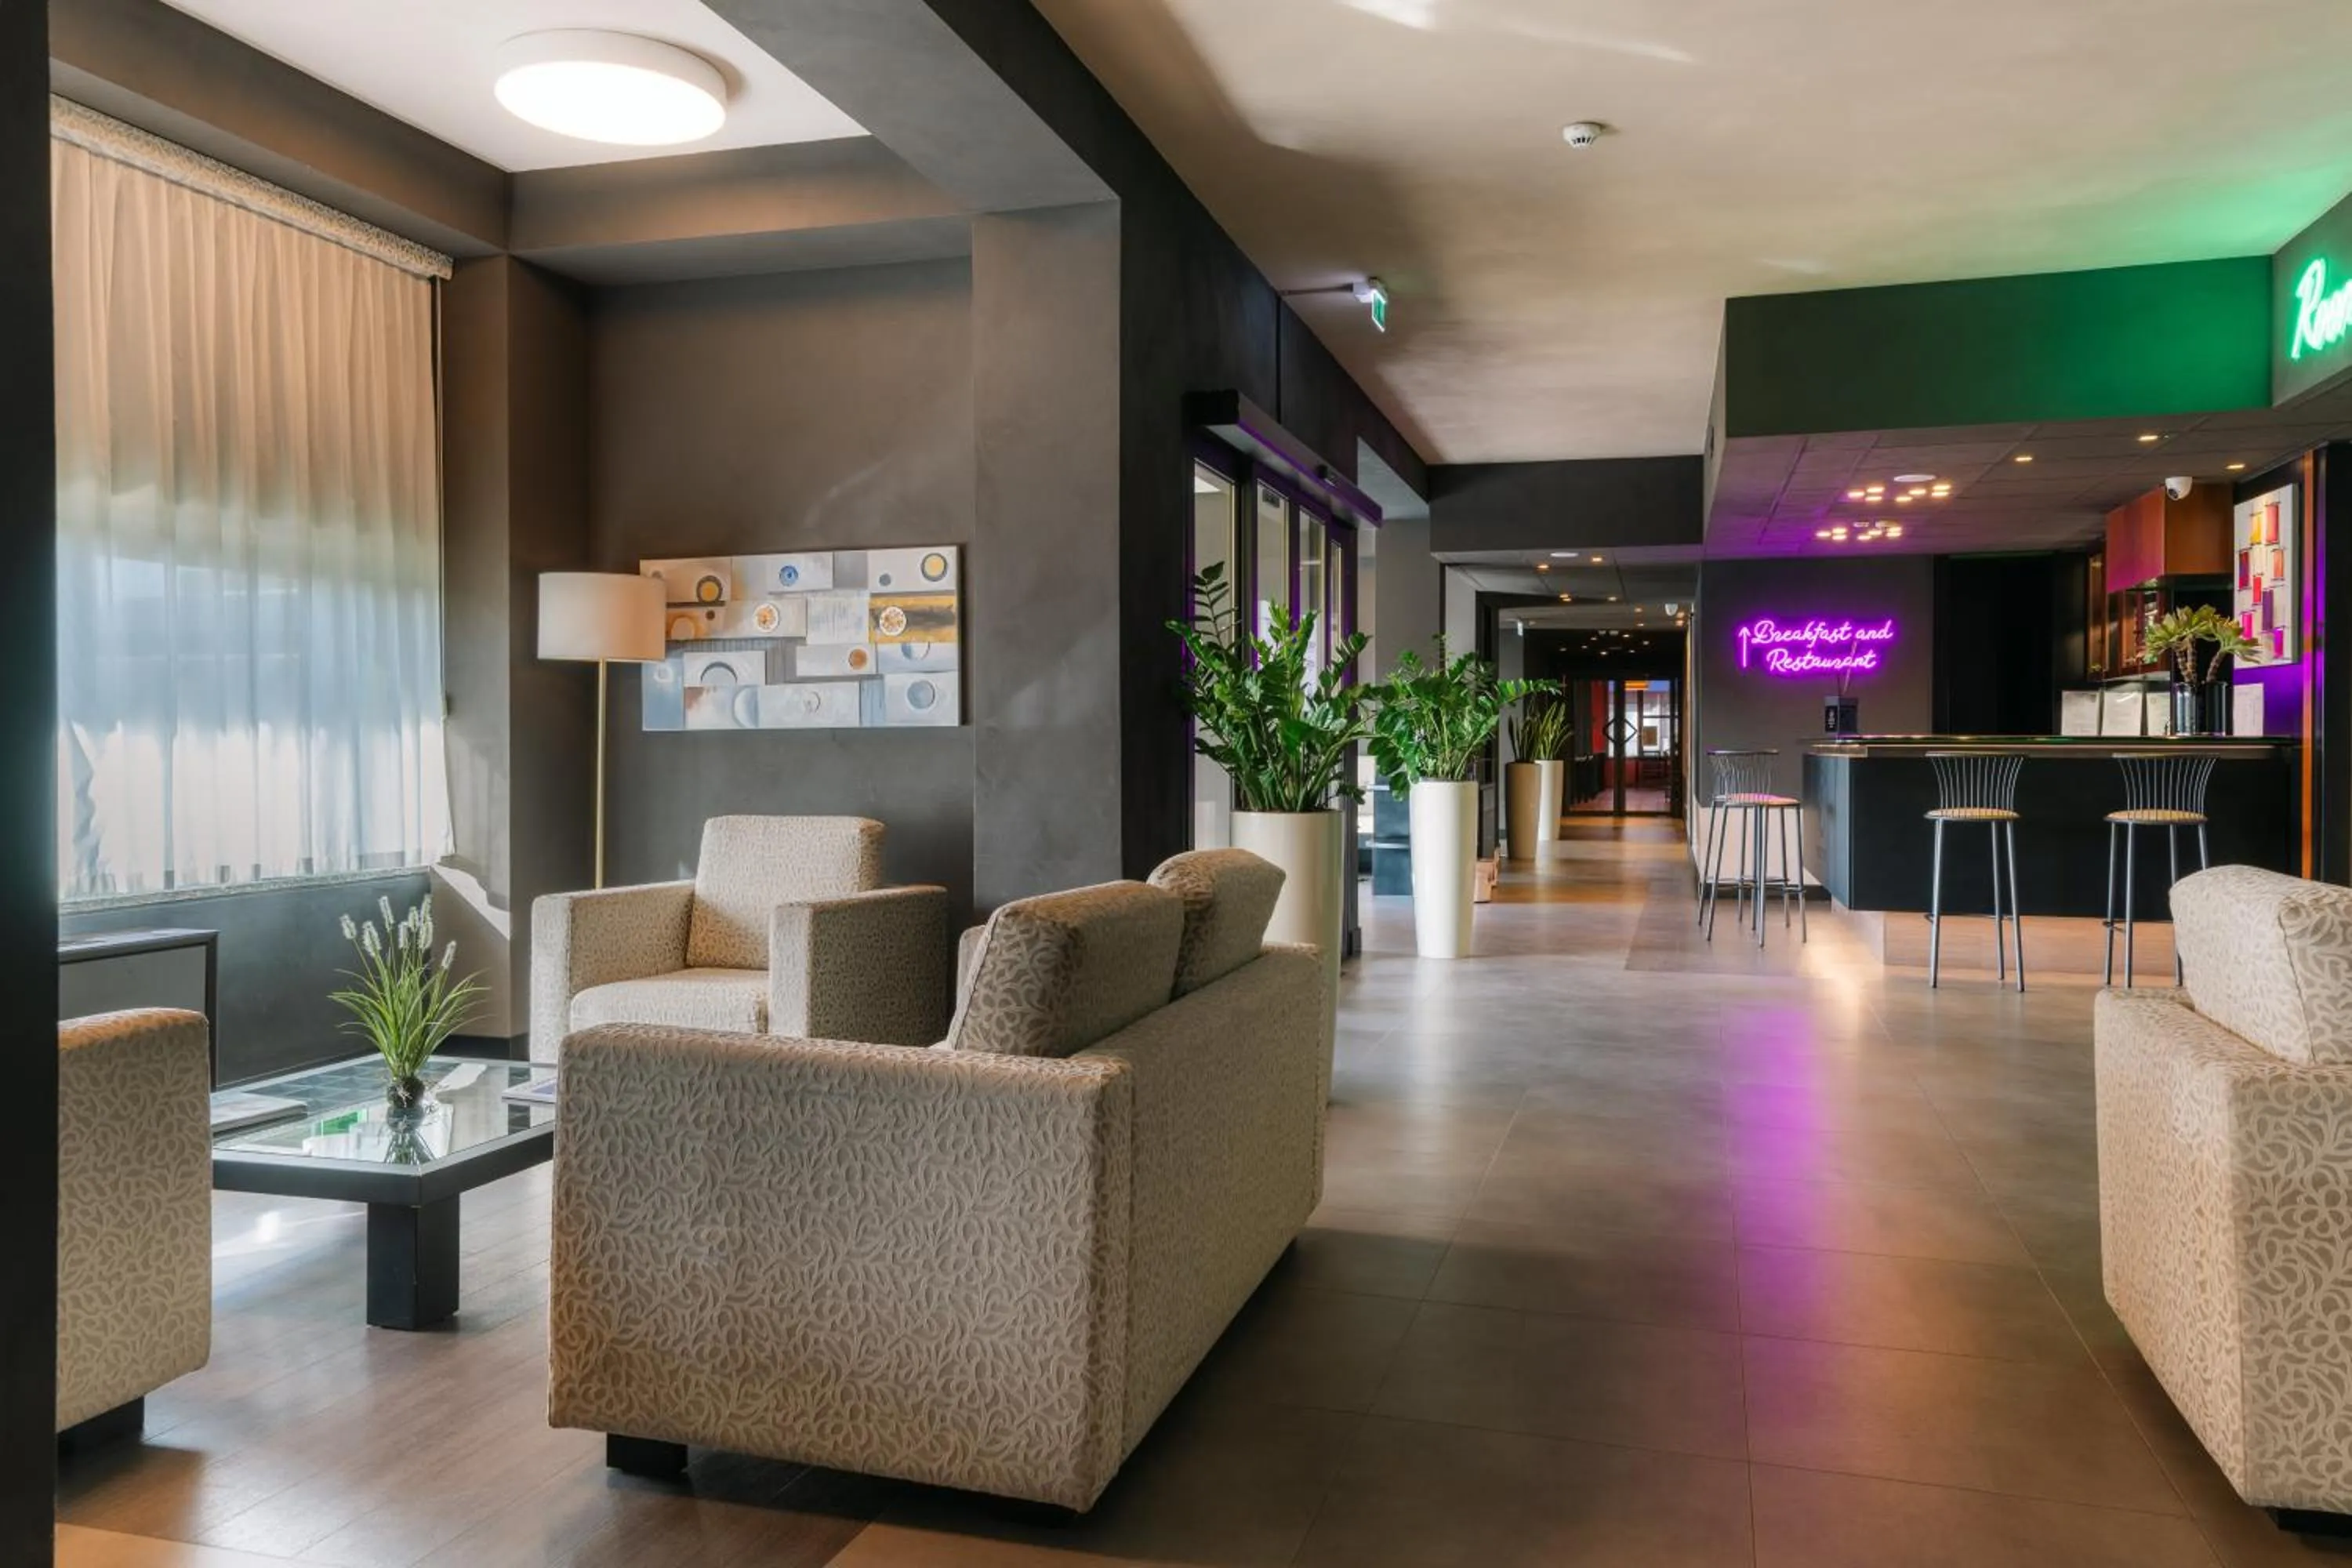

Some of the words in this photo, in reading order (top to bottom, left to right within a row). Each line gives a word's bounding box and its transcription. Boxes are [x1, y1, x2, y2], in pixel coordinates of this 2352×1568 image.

[1751, 620, 1852, 648] Breakfast
[1855, 619, 1894, 641] and
[1766, 648, 1877, 672] Restaurant
